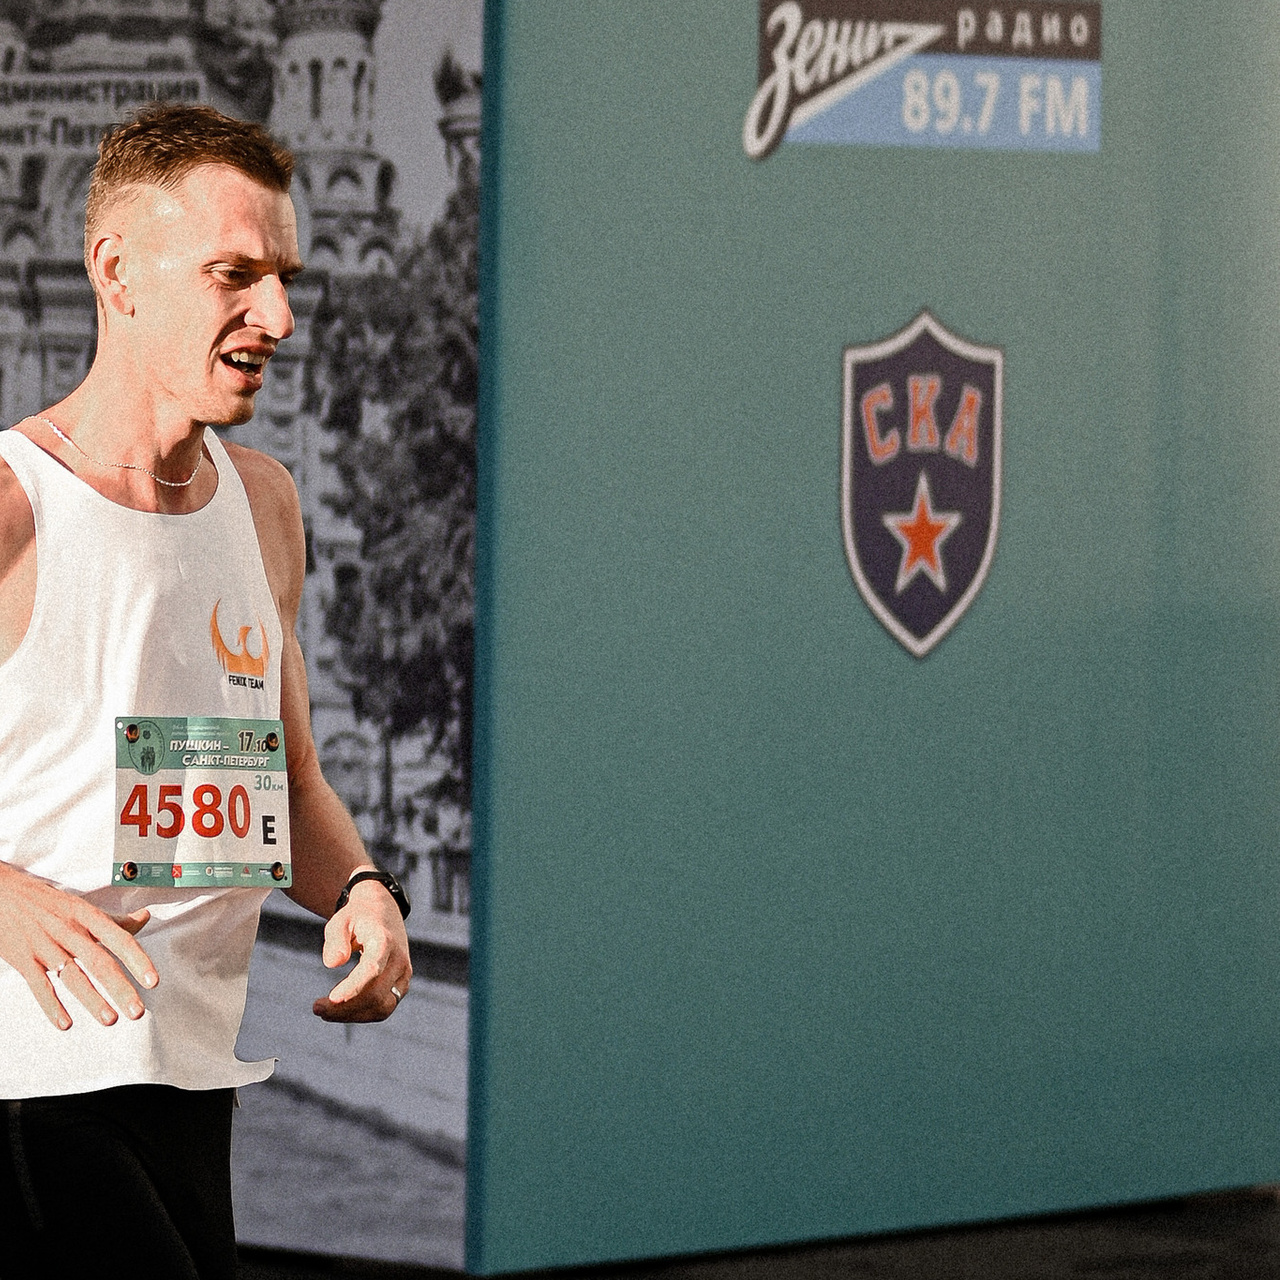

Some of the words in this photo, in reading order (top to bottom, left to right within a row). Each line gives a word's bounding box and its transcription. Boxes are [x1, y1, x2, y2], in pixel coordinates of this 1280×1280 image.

[957, 8, 1090, 50] радио
[742, 0, 946, 158] Зенит
[901, 69, 1001, 135] 89.7
[1020, 73, 1090, 138] FM
[859, 372, 983, 469] СКА
[247, 677, 265, 691] TEAM
[169, 739, 222, 752] ПУШКИН
[182, 754, 270, 768] САНКТ-ПЕТЕРБУРГ
[119, 783, 251, 839] 4580
